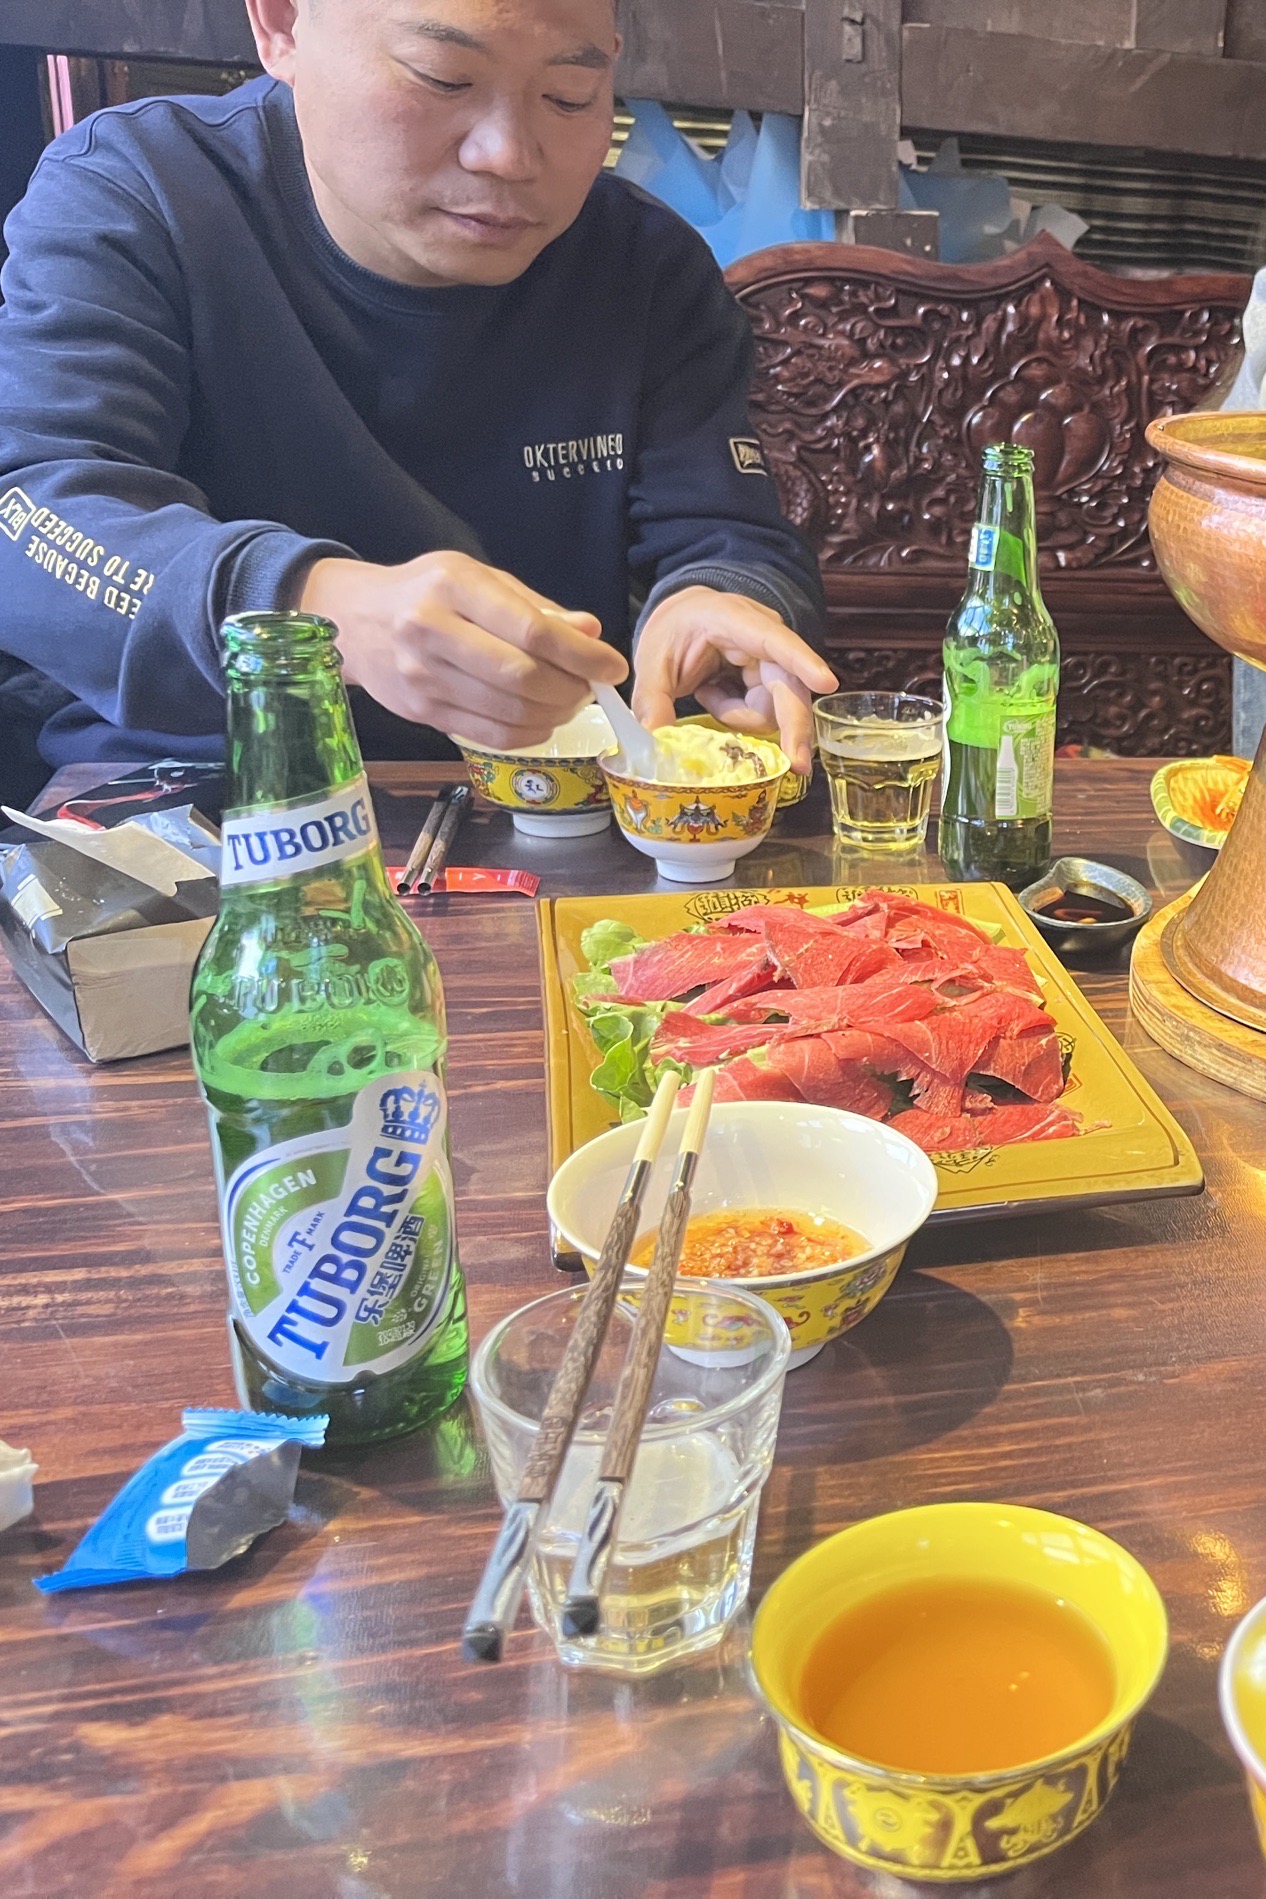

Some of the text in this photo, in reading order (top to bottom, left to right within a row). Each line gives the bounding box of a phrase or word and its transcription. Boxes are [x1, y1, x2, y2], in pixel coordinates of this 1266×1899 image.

[25, 535, 100, 600] BECAUSE
[30, 507, 105, 567] SUCCEED
[103, 555, 130, 584] TO
[227, 797, 371, 871] TUBORG
[240, 1168, 317, 1286] COPENHAGEN
[259, 1206, 288, 1247] DENMARK
[267, 1146, 423, 1361] TUBORG
[283, 1249, 303, 1274] TRADE
[306, 1211, 325, 1236] MARK
[355, 1213, 425, 1326] 乐堡啤酒
[415, 1240, 443, 1314] GREEN
